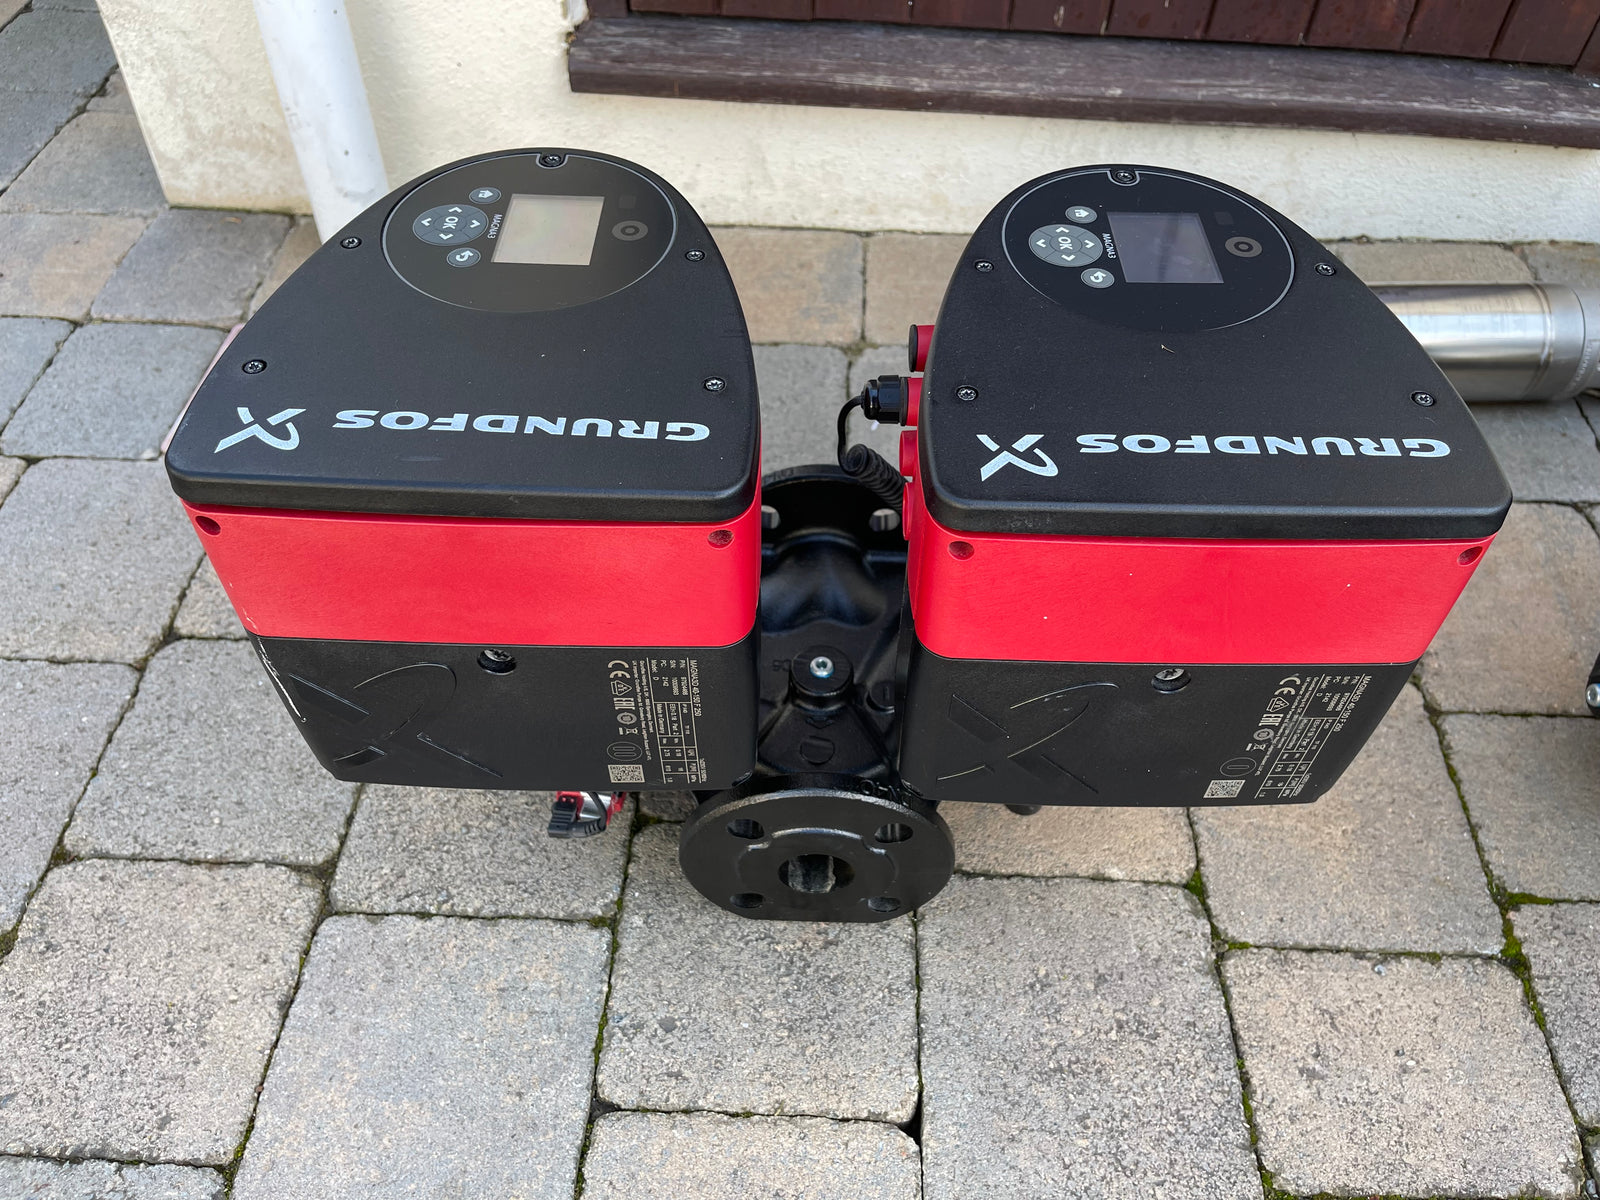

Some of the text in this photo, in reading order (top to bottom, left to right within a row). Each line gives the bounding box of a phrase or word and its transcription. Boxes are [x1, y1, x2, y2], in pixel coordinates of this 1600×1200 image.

[442, 216, 459, 230] OK
[487, 214, 503, 239] MAGNA3
[1058, 236, 1073, 250] OK
[1102, 233, 1117, 259] MAGNA3
[332, 409, 711, 442] GRUNDFOS
[1076, 433, 1451, 457] GRUNDFOS
